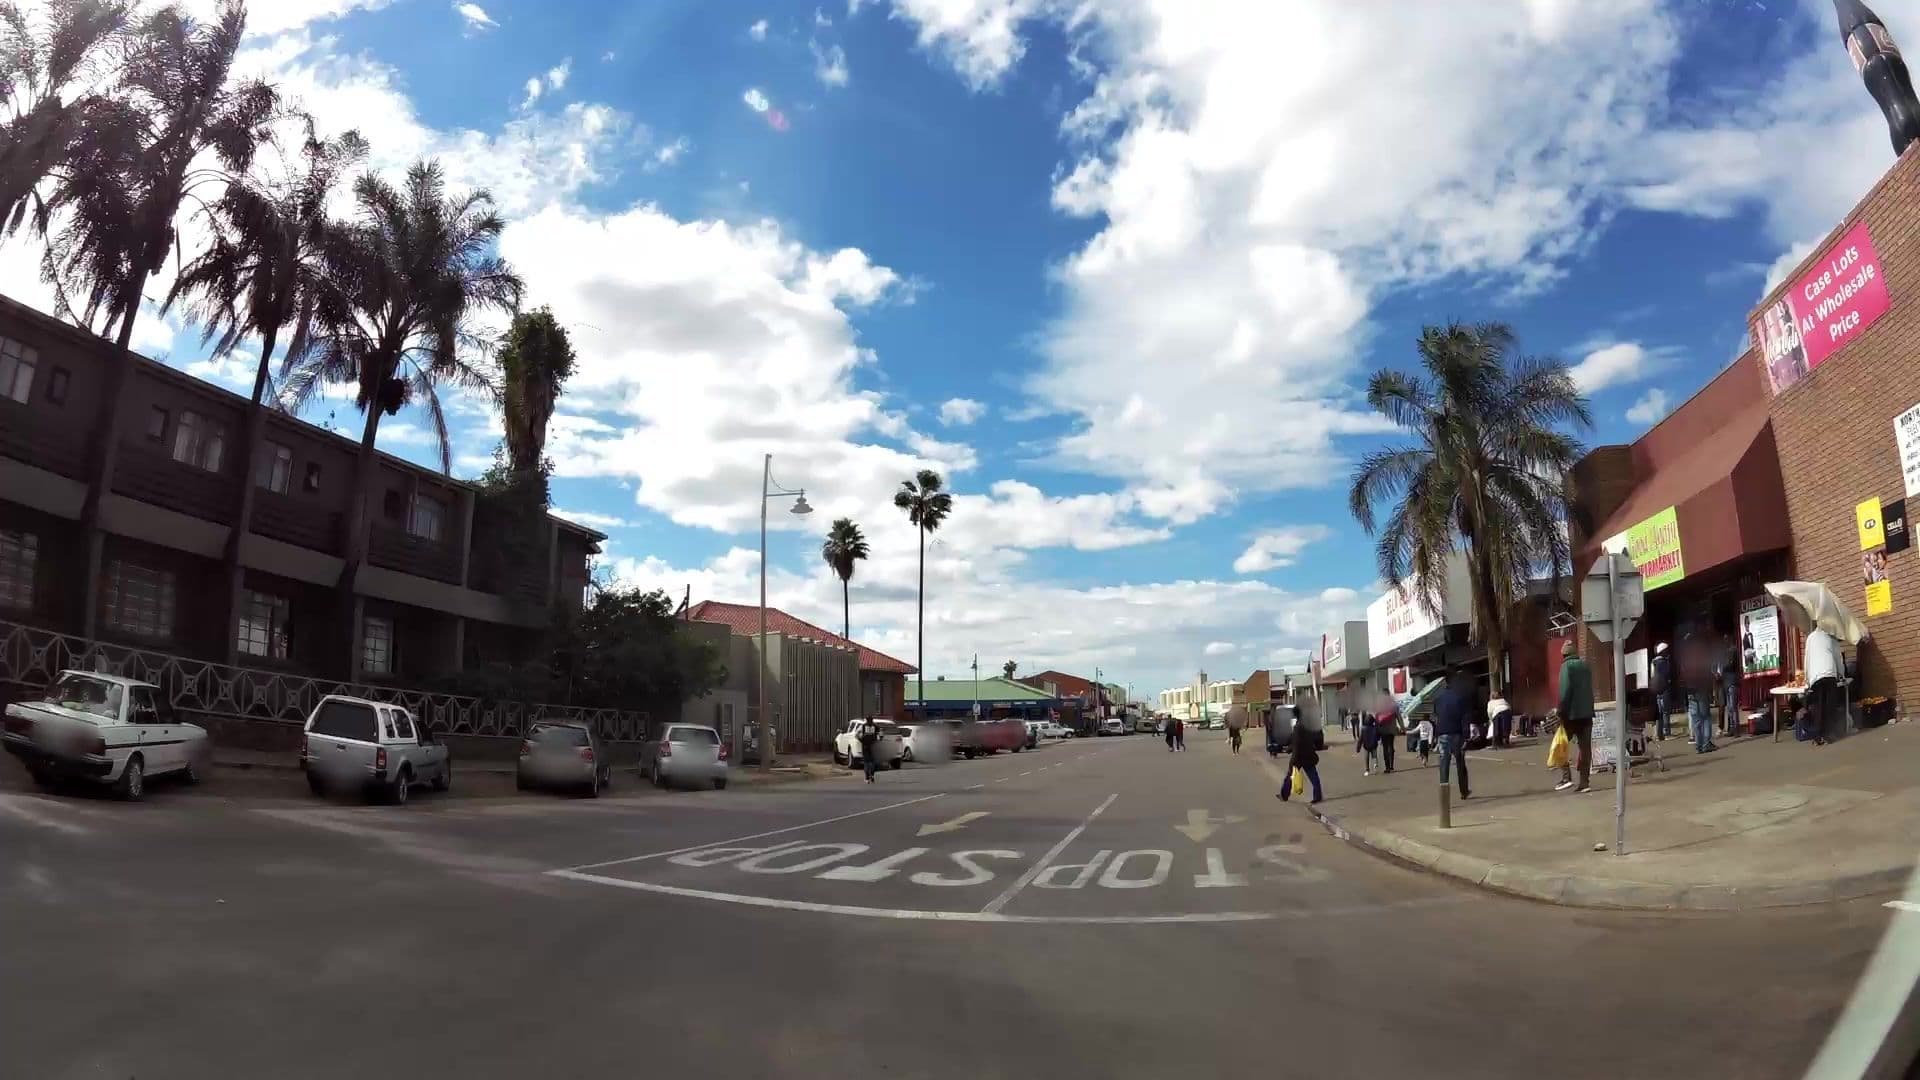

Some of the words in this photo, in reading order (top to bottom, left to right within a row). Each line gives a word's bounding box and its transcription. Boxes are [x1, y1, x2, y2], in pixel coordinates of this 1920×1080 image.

[1804, 270, 1832, 301] Case
[1831, 245, 1859, 277] Lots
[1801, 314, 1816, 337] At
[1814, 263, 1875, 322] Wholesale
[1829, 310, 1860, 342] Price
[1637, 548, 1681, 578] PERMARKET
[667, 840, 1025, 887] STOP
[1032, 843, 1333, 889] STOP
